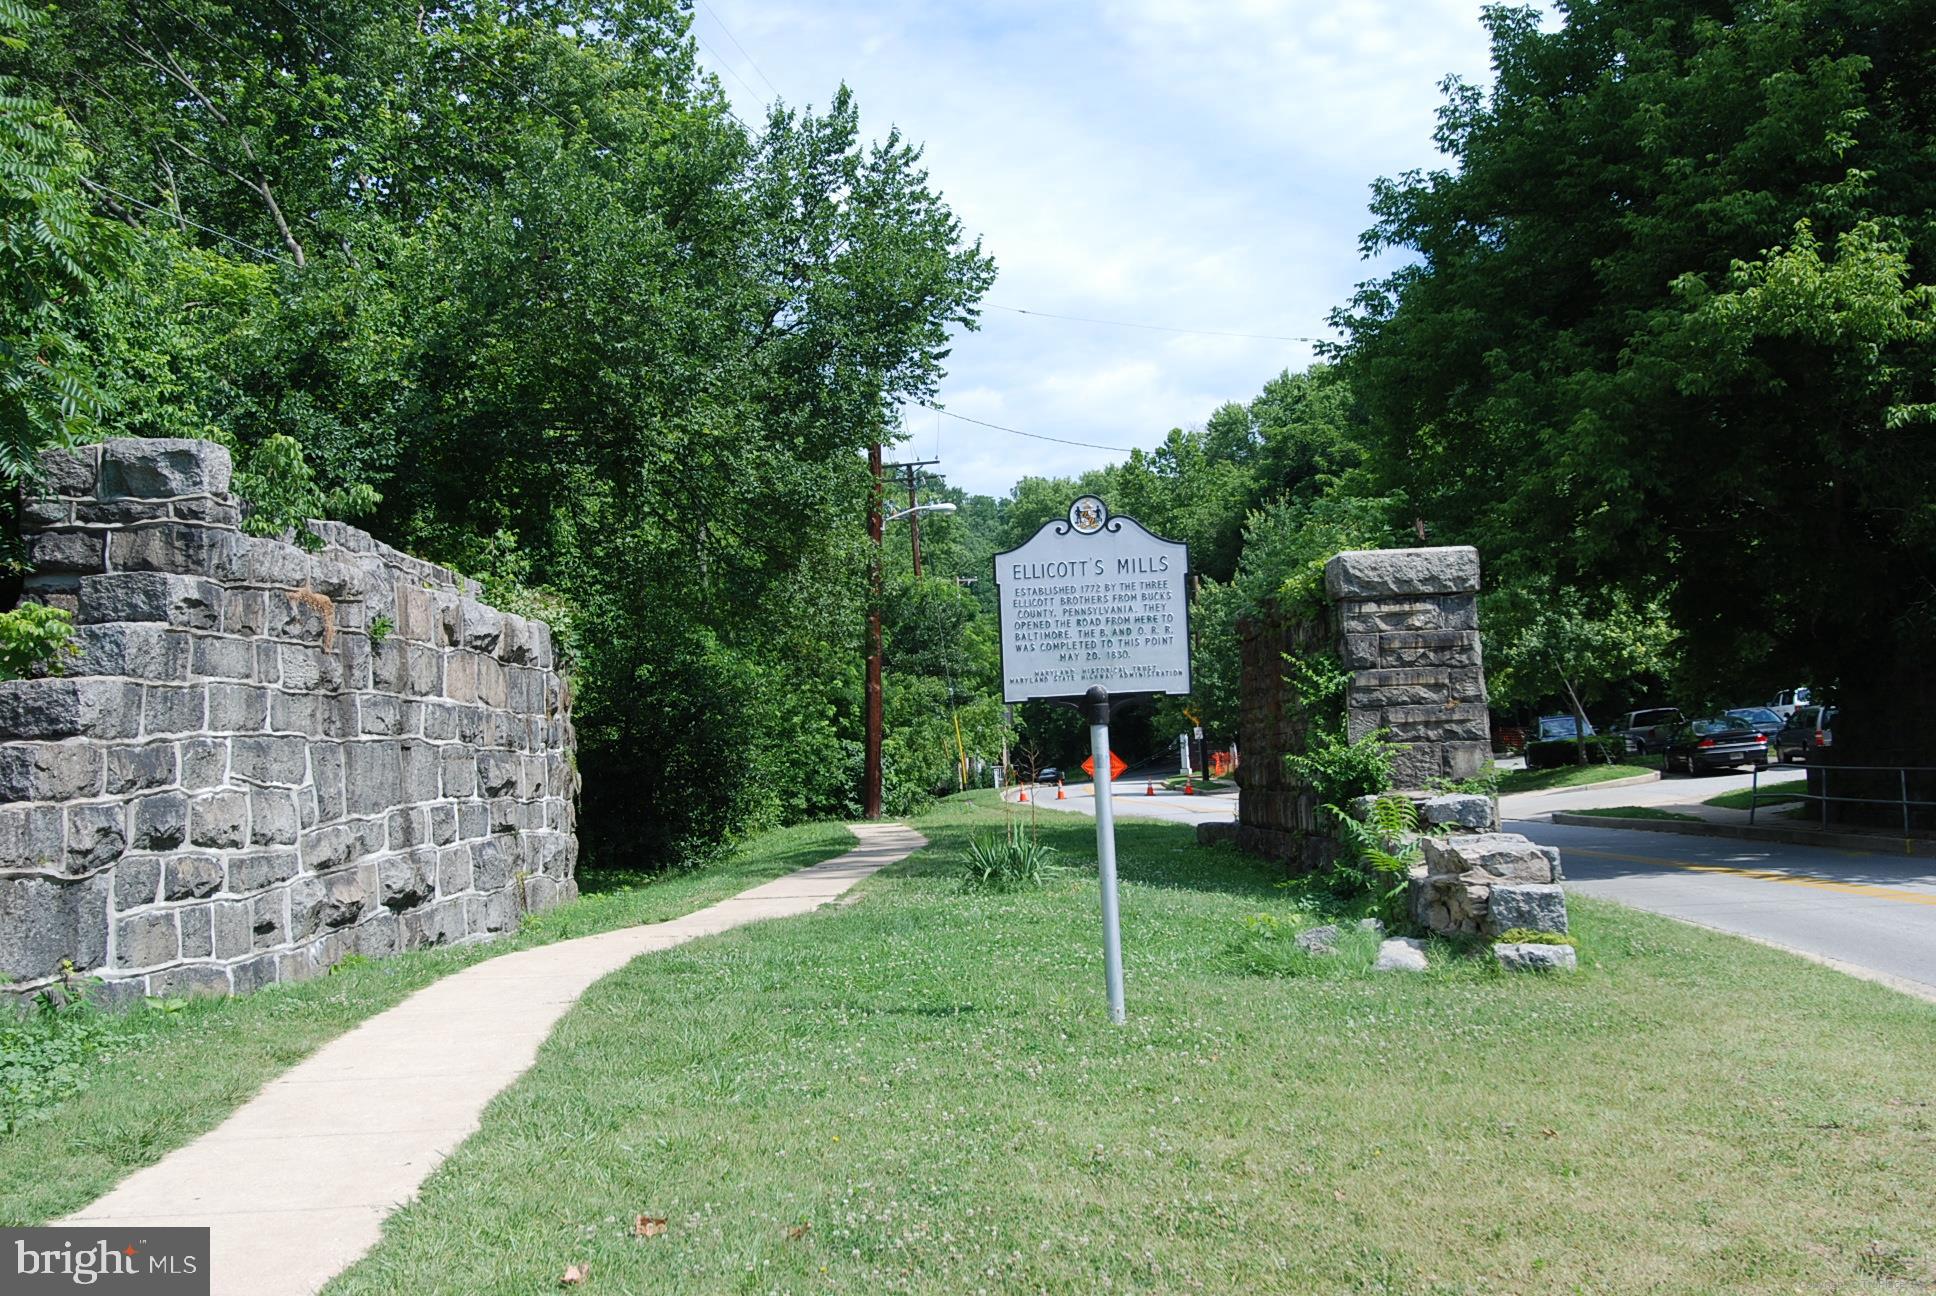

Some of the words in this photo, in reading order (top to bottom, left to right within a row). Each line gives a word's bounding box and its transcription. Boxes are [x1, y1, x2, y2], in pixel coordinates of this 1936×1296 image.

[1013, 557, 1104, 579] ELLICOTT'S
[1118, 556, 1168, 574] MILLS
[1015, 586, 1076, 596] ESTABLISHED
[1105, 583, 1116, 592] BY
[1120, 582, 1136, 590] THE
[1140, 580, 1168, 589] THREE
[1013, 598, 1054, 607] ELLICOTT
[1060, 595, 1108, 605] BROTHERS
[1113, 594, 1137, 602] FROM
[1142, 592, 1171, 600] BUCKS
[1063, 605, 1138, 616] PENNSYLVANIA.
[1144, 603, 1166, 612] THEY
[1014, 621, 1050, 629] OPENED
[1056, 619, 1071, 627] THE
[1076, 617, 1101, 626] ROAD
[1106, 616, 1130, 624] FROM
[1134, 615, 1158, 623] HERE
[1162, 614, 1173, 622] TO
[1078, 630, 1095, 638] THE
[1016, 644, 1035, 652] WAS
[1040, 641, 1096, 651] COMPLETED
[1119, 638, 1140, 647] THIS
[1146, 637, 1173, 646] POINT
[1060, 653, 1079, 661] MAY
